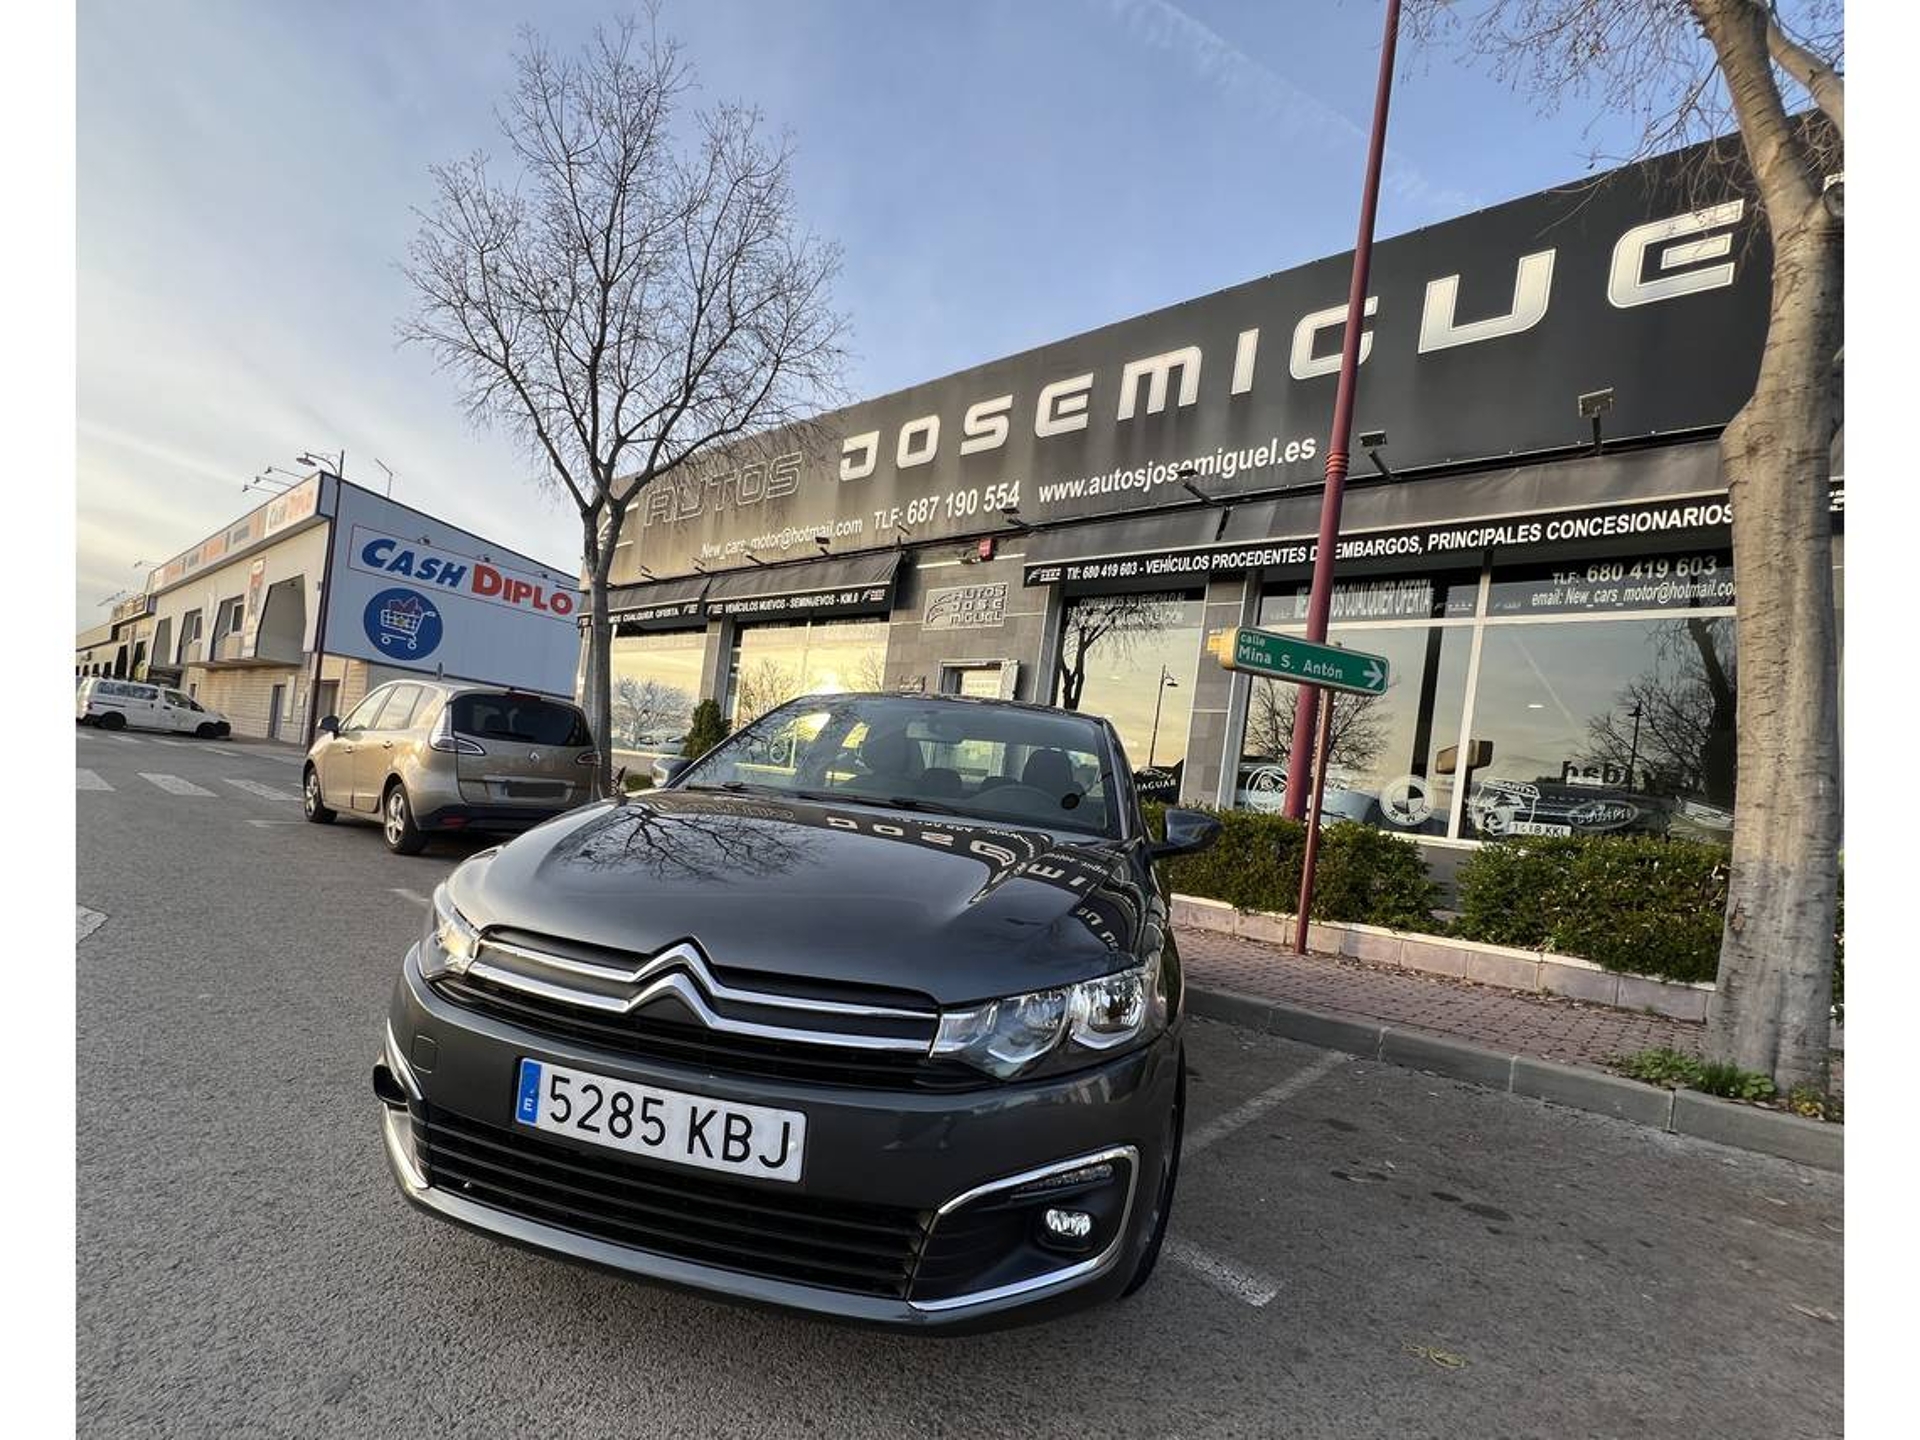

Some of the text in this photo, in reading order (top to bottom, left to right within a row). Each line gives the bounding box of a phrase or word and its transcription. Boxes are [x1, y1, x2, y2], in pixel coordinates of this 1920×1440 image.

[644, 197, 1745, 527] AUTOS JOSEMIGUE
[907, 496, 940, 525] 687
[946, 489, 978, 518] 190
[983, 480, 1021, 512] 554
[1039, 437, 1317, 503] www.autosjosemiguel.es
[1101, 563, 1119, 577] 419
[1146, 554, 1210, 574] VEHÍCULOS
[1210, 546, 1307, 569] PROCEDENTES
[1428, 522, 1542, 551] PRINCIPALES
[1546, 503, 1733, 540] CONCESIONARIOS
[362, 538, 573, 616] CASH DIPLO
[1564, 579, 1738, 608] New_cars_motor@hotmail.co
[1586, 562, 1623, 583] 680
[1629, 559, 1670, 580] 419
[1675, 555, 1717, 577] 603
[1238, 645, 1344, 680] Mina S. Antón
[1240, 633, 1266, 647] calle
[523, 1097, 534, 1112] E
[549, 1074, 791, 1169] 5285 KBJ
